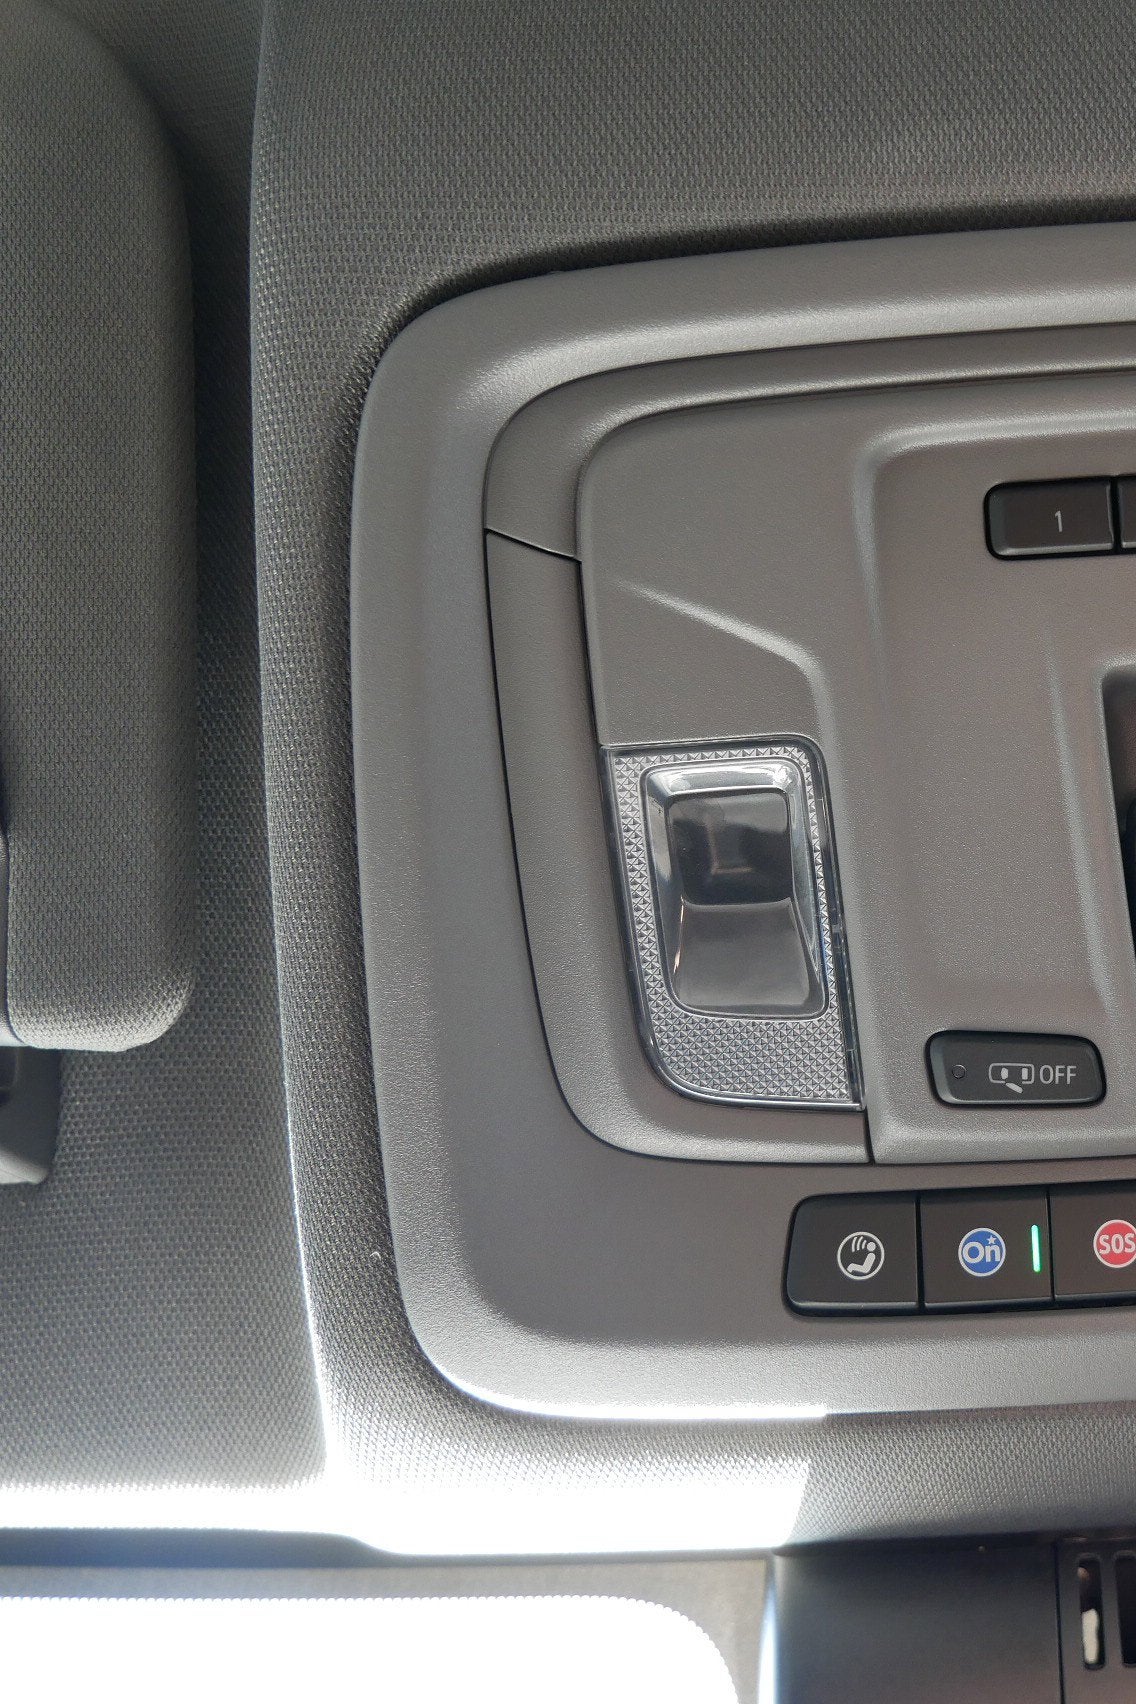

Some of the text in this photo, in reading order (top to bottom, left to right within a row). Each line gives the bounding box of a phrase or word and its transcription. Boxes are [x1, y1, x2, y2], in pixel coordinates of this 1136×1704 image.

[1054, 510, 1063, 532] 1
[1040, 1065, 1077, 1085] OFF
[963, 1241, 1000, 1264] On
[1099, 1232, 1136, 1256] SOS
